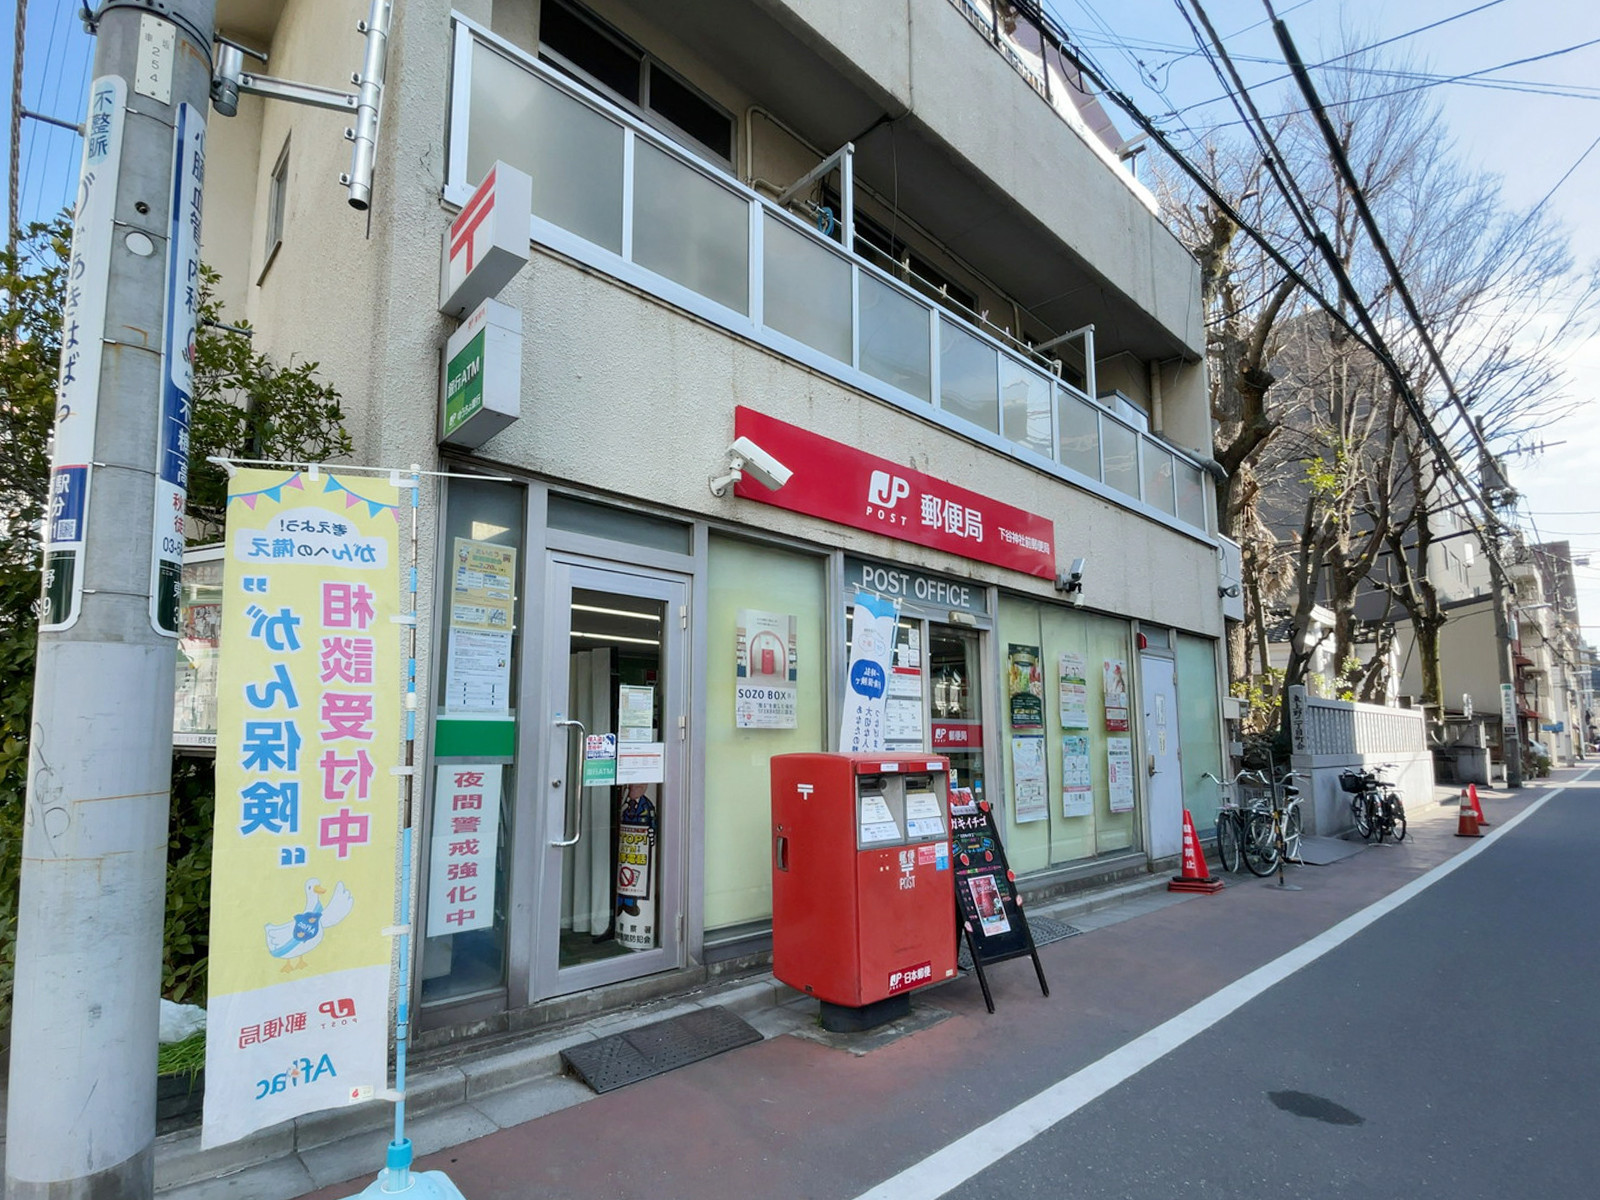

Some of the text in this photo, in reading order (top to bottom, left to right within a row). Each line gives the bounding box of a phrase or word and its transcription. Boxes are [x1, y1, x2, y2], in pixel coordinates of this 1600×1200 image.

[89, 90, 113, 158] 不整脈
[866, 506, 908, 527] POST
[921, 493, 984, 543] 郵便局
[862, 565, 971, 608] POST OFFICE
[738, 688, 765, 700] SOZO
[767, 690, 786, 700] BOX
[446, 771, 485, 926] 夜間警戒強化中
[899, 849, 915, 865] 郵便
[899, 875, 915, 890] POST
[904, 965, 931, 984] 日本郵便
